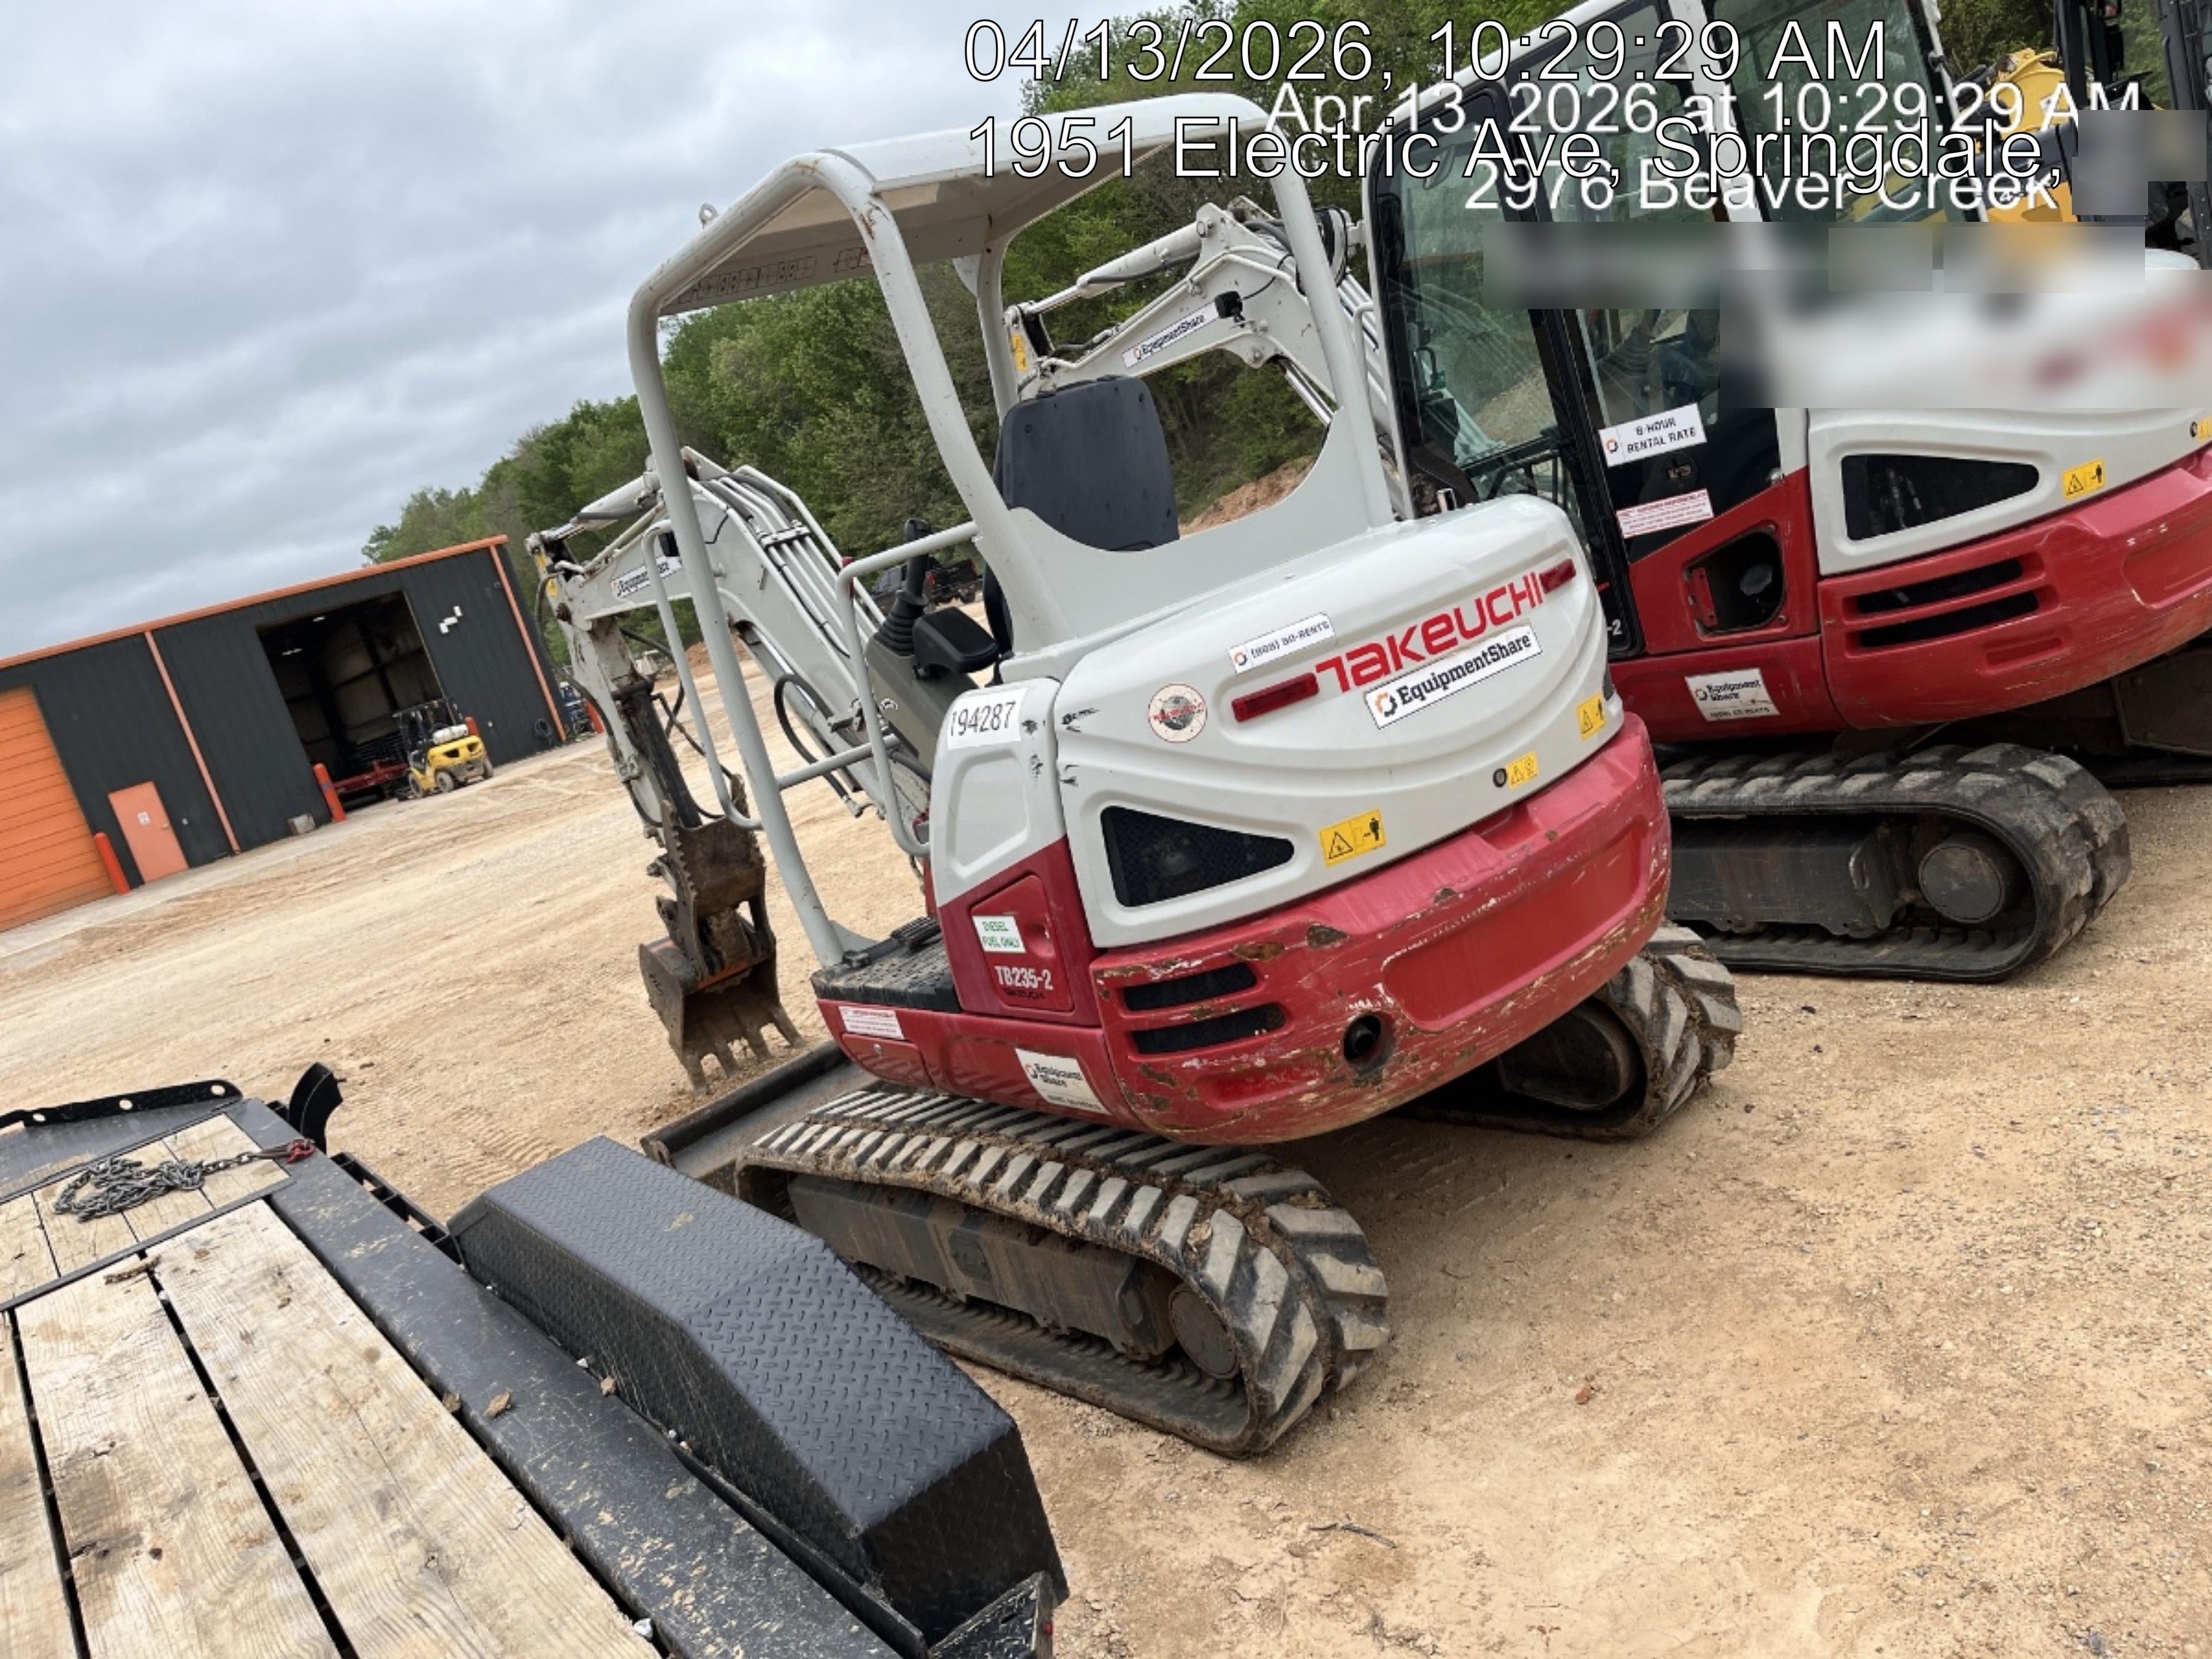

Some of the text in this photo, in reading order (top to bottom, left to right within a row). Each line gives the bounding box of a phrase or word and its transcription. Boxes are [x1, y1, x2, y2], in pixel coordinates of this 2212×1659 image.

[1626, 426, 1696, 453] RENTAL RATE
[1314, 571, 1544, 694] TAKEUCHI
[1395, 634, 1532, 706] EquipmentShare
[950, 700, 1017, 737] 194287
[994, 965, 1054, 990] TB235-2
